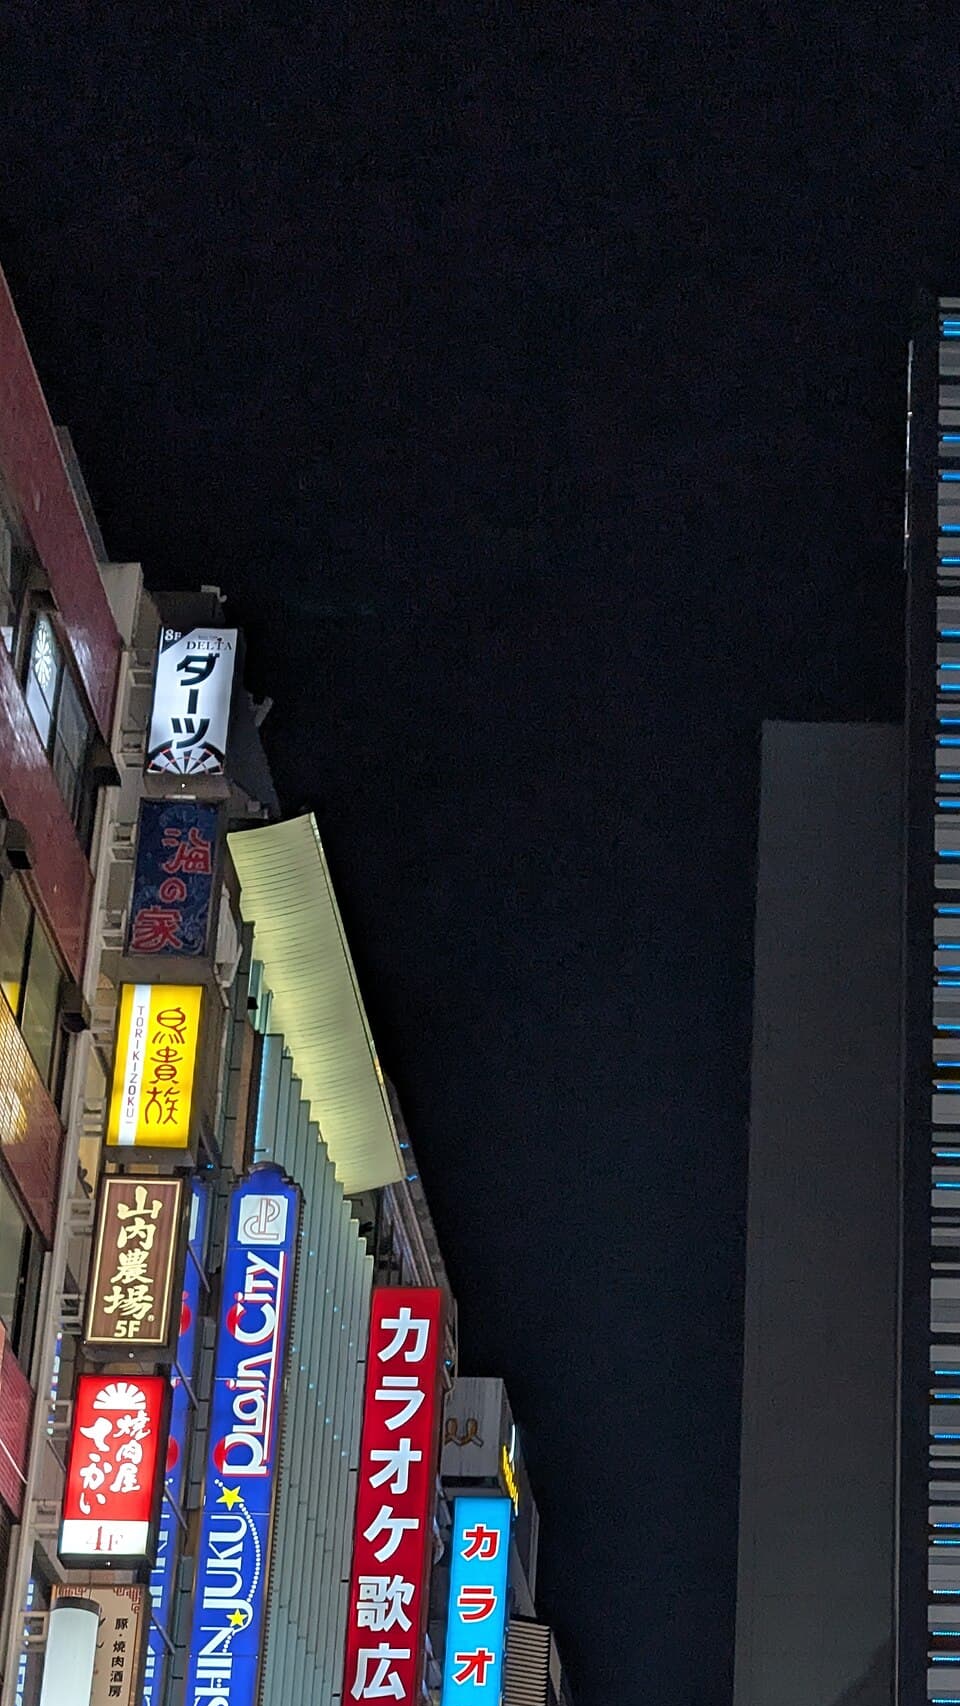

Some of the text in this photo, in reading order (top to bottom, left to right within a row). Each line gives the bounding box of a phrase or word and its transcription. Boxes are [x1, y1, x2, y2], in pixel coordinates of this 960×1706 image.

[165, 629, 182, 641] 8F
[186, 640, 232, 650] DELTA
[171, 653, 220, 749] ダーツ
[130, 827, 211, 952] 海の家
[126, 1005, 145, 1118] TORIKIZOKU
[104, 1186, 162, 1319] 山内農場
[114, 1320, 141, 1338] 5F
[110, 1410, 151, 1493] 焼肉屋
